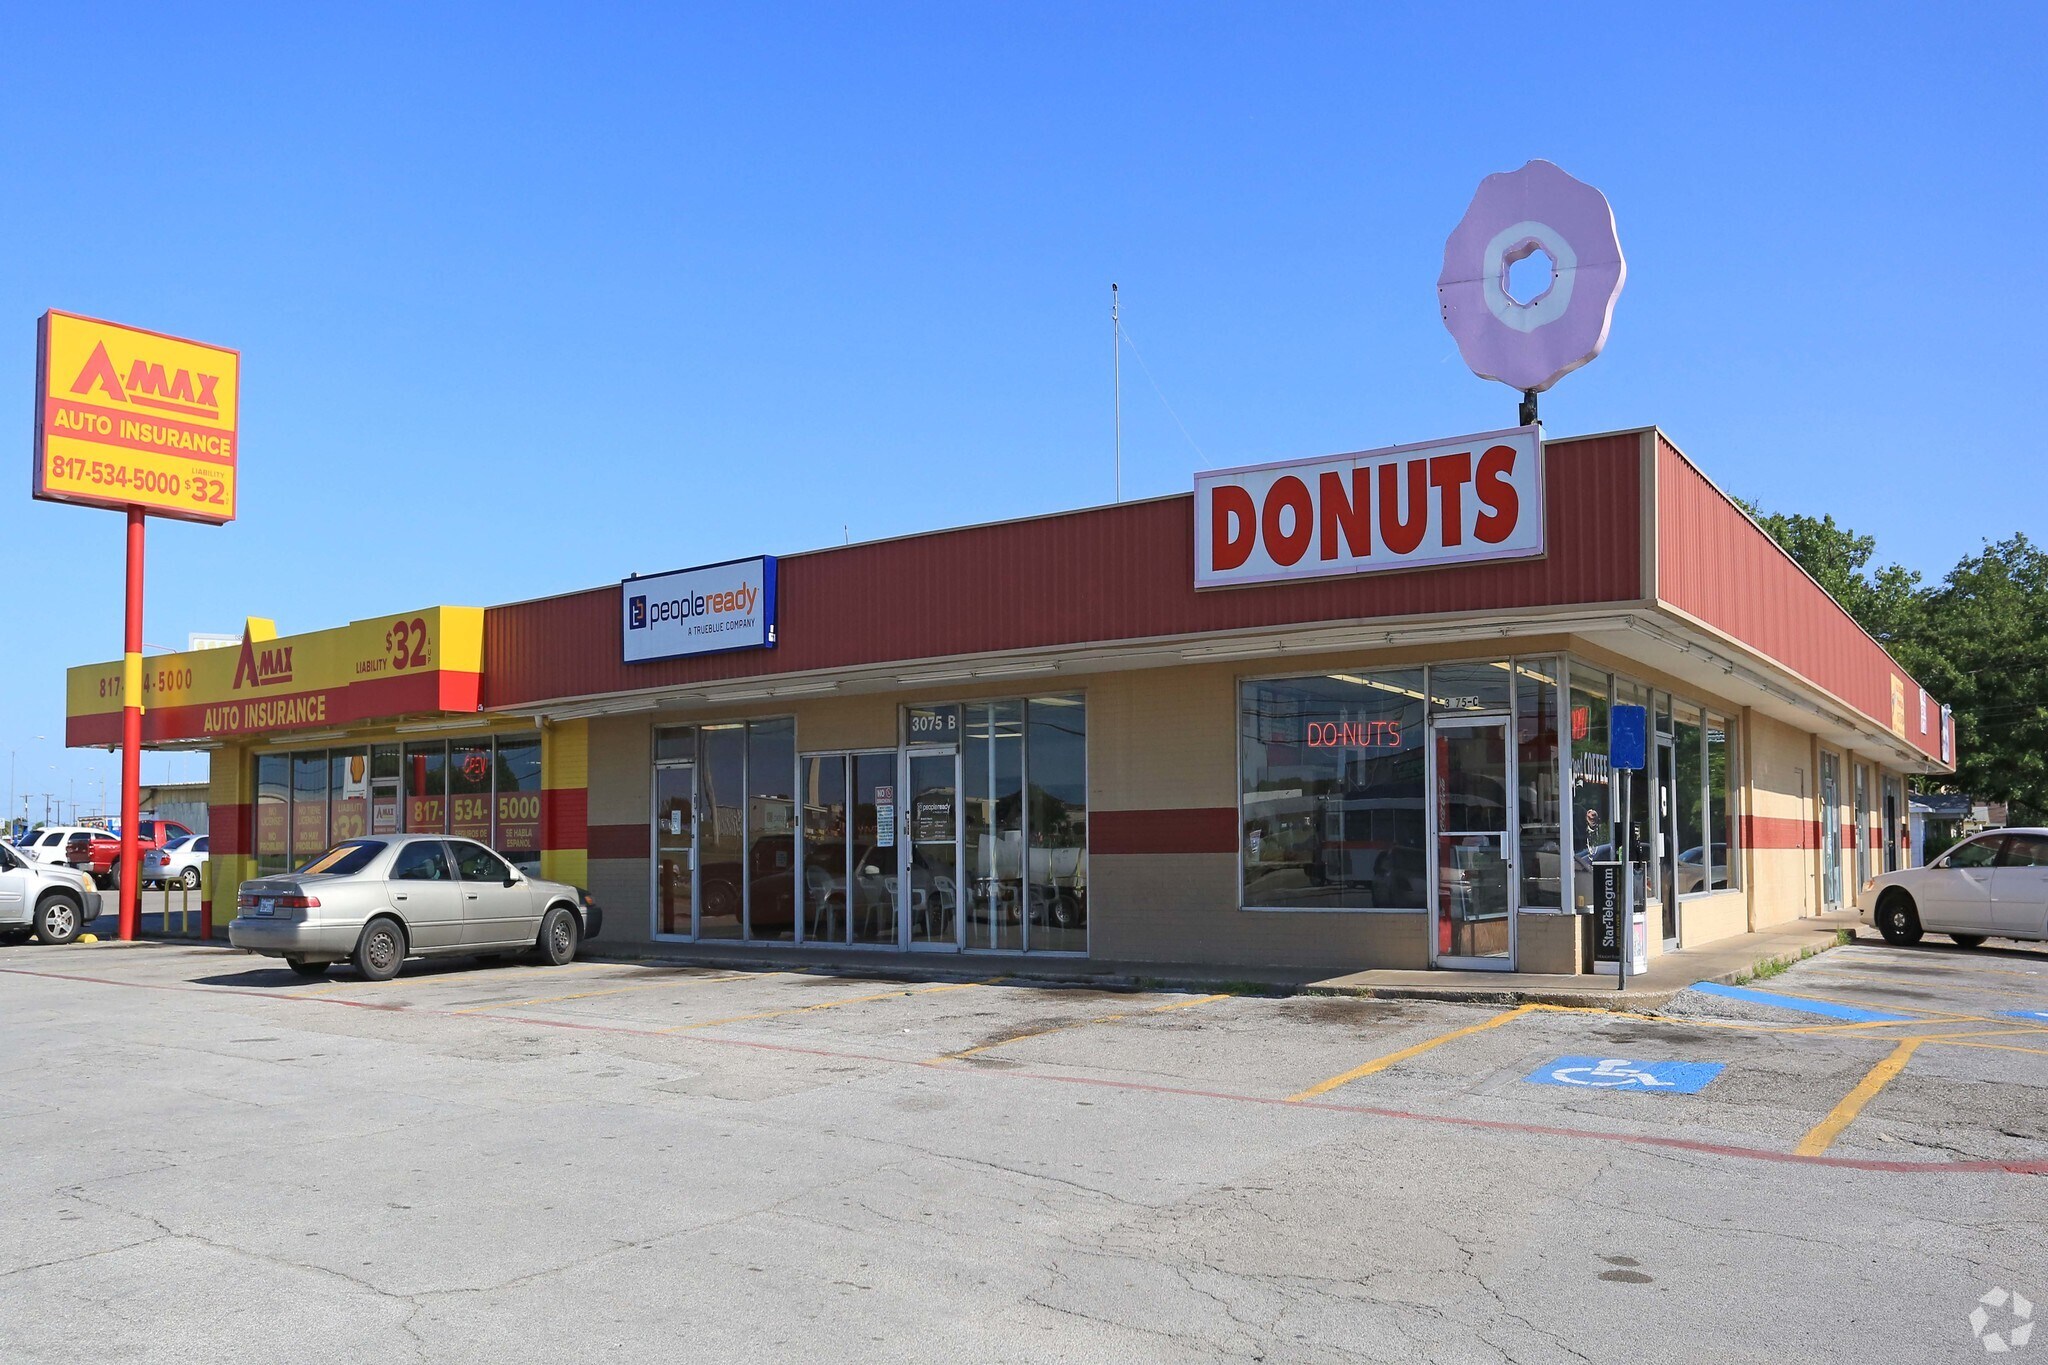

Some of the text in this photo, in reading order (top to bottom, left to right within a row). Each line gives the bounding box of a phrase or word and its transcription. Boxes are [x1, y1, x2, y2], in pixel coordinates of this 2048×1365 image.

[54, 408, 231, 458] AUTO INSURANCE
[52, 455, 181, 496] 817-534-5000
[191, 467, 225, 479] LIABILITY
[184, 476, 225, 505] $32
[1212, 445, 1519, 571] DONUTS
[650, 581, 758, 631] peopleready
[688, 618, 756, 636] A TRUEBLUE COMPANY
[356, 617, 427, 674] LIABILITY $32
[203, 695, 326, 733] AUTO INSURANCE
[912, 715, 956, 731] 3075 B
[1308, 721, 1400, 747] DO-NUTS
[1584, 752, 1609, 784] COFFEE
[499, 796, 540, 819] 5000
[506, 829, 532, 838] SE HABLA
[1602, 867, 1615, 947] Star-Telegram
